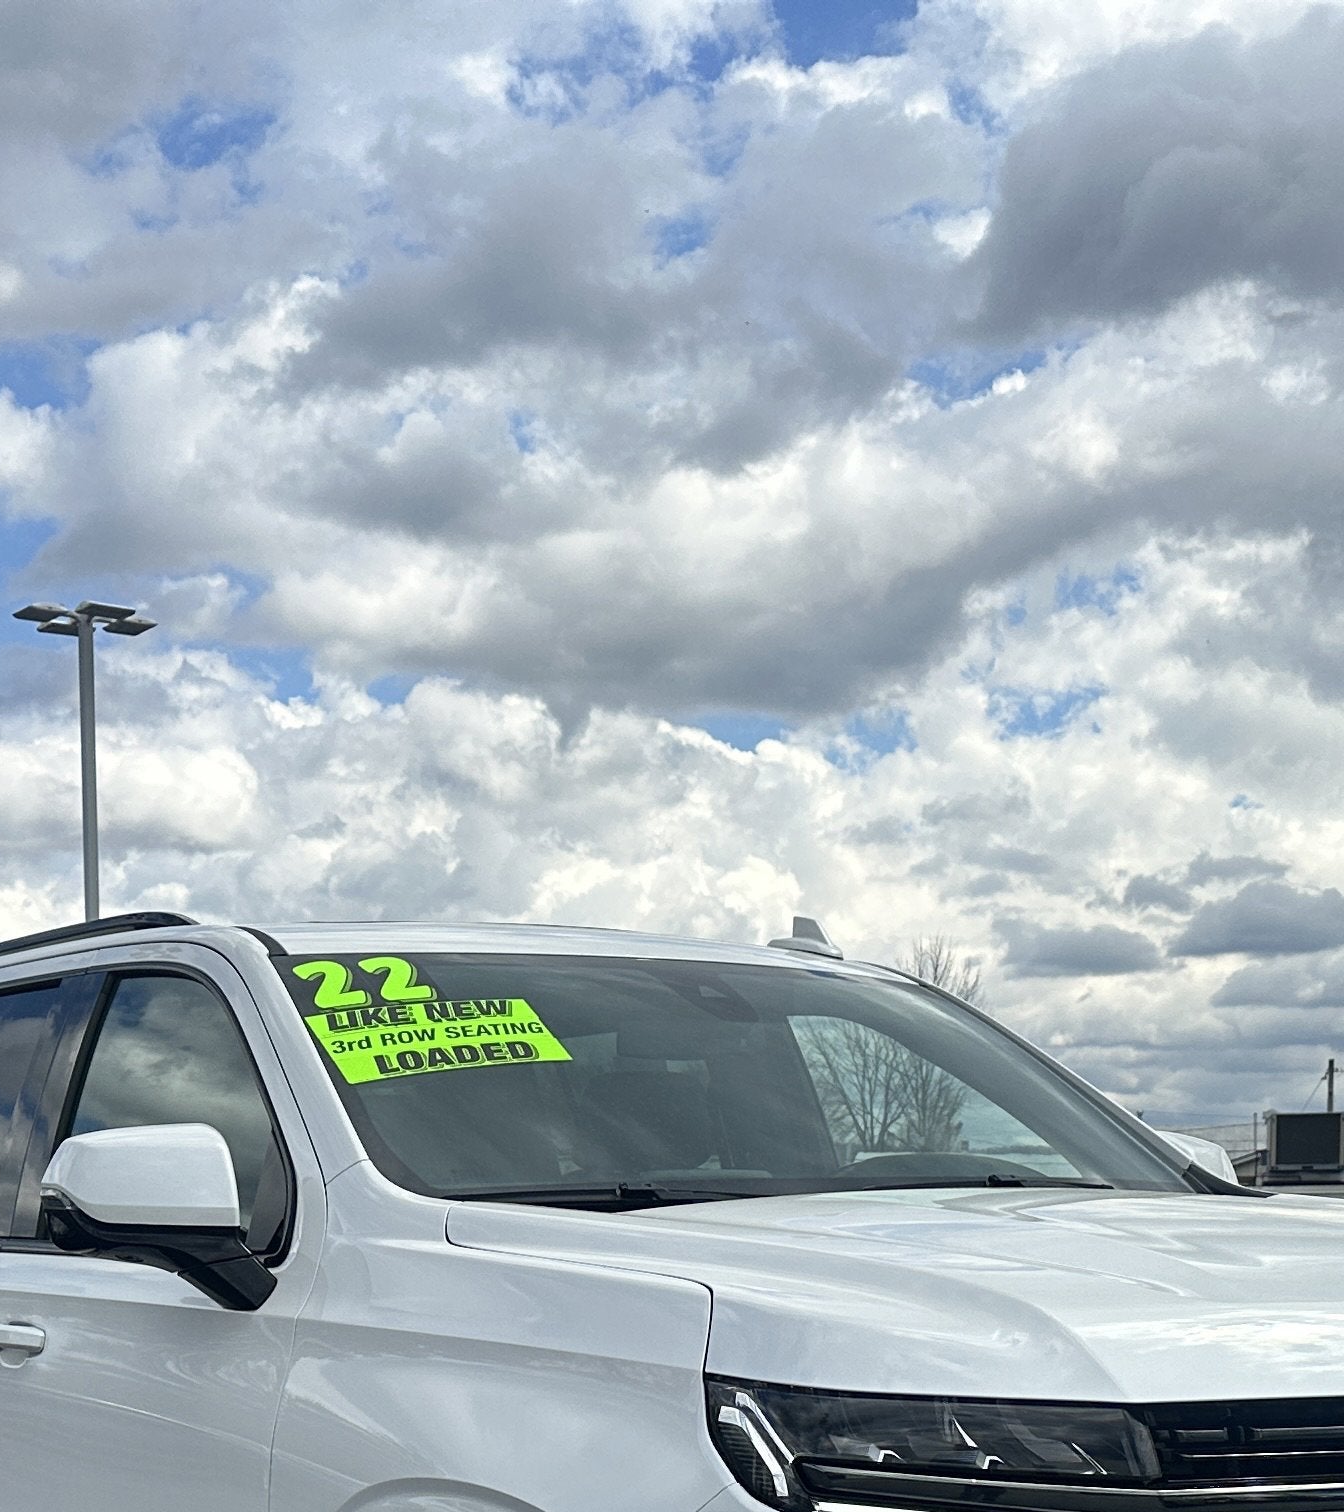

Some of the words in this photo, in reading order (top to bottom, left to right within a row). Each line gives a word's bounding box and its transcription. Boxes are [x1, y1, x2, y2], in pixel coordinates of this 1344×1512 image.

[292, 956, 437, 1011] 22
[327, 1005, 416, 1032] LIKE
[425, 999, 512, 1023] NEW
[331, 1036, 372, 1055] 3rd
[380, 1027, 435, 1046] ROW
[446, 1021, 544, 1039] SEATING
[374, 1041, 539, 1075] LOADED
